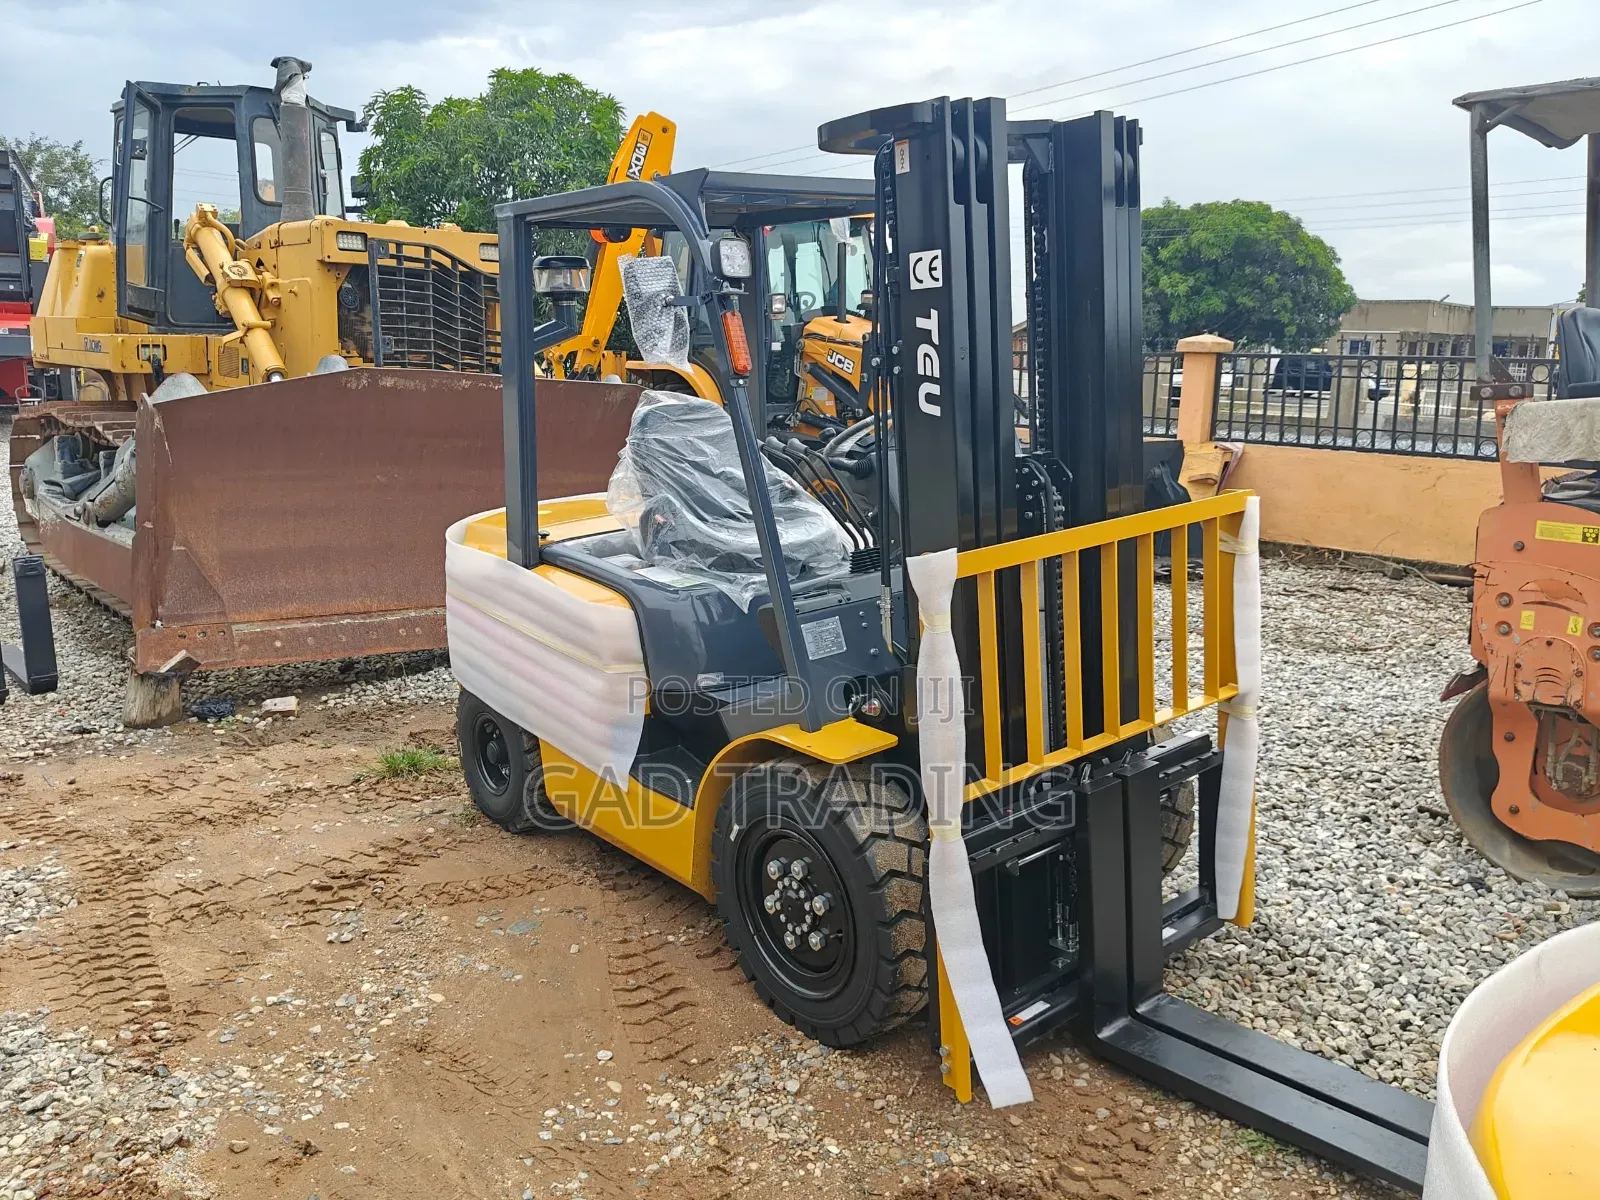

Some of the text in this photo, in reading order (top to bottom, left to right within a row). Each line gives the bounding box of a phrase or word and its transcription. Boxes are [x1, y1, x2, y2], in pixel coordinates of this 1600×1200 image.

[629, 142, 648, 178] 3DX
[912, 254, 940, 284] CE
[827, 351, 854, 374] JCB
[915, 308, 941, 417] TEU
